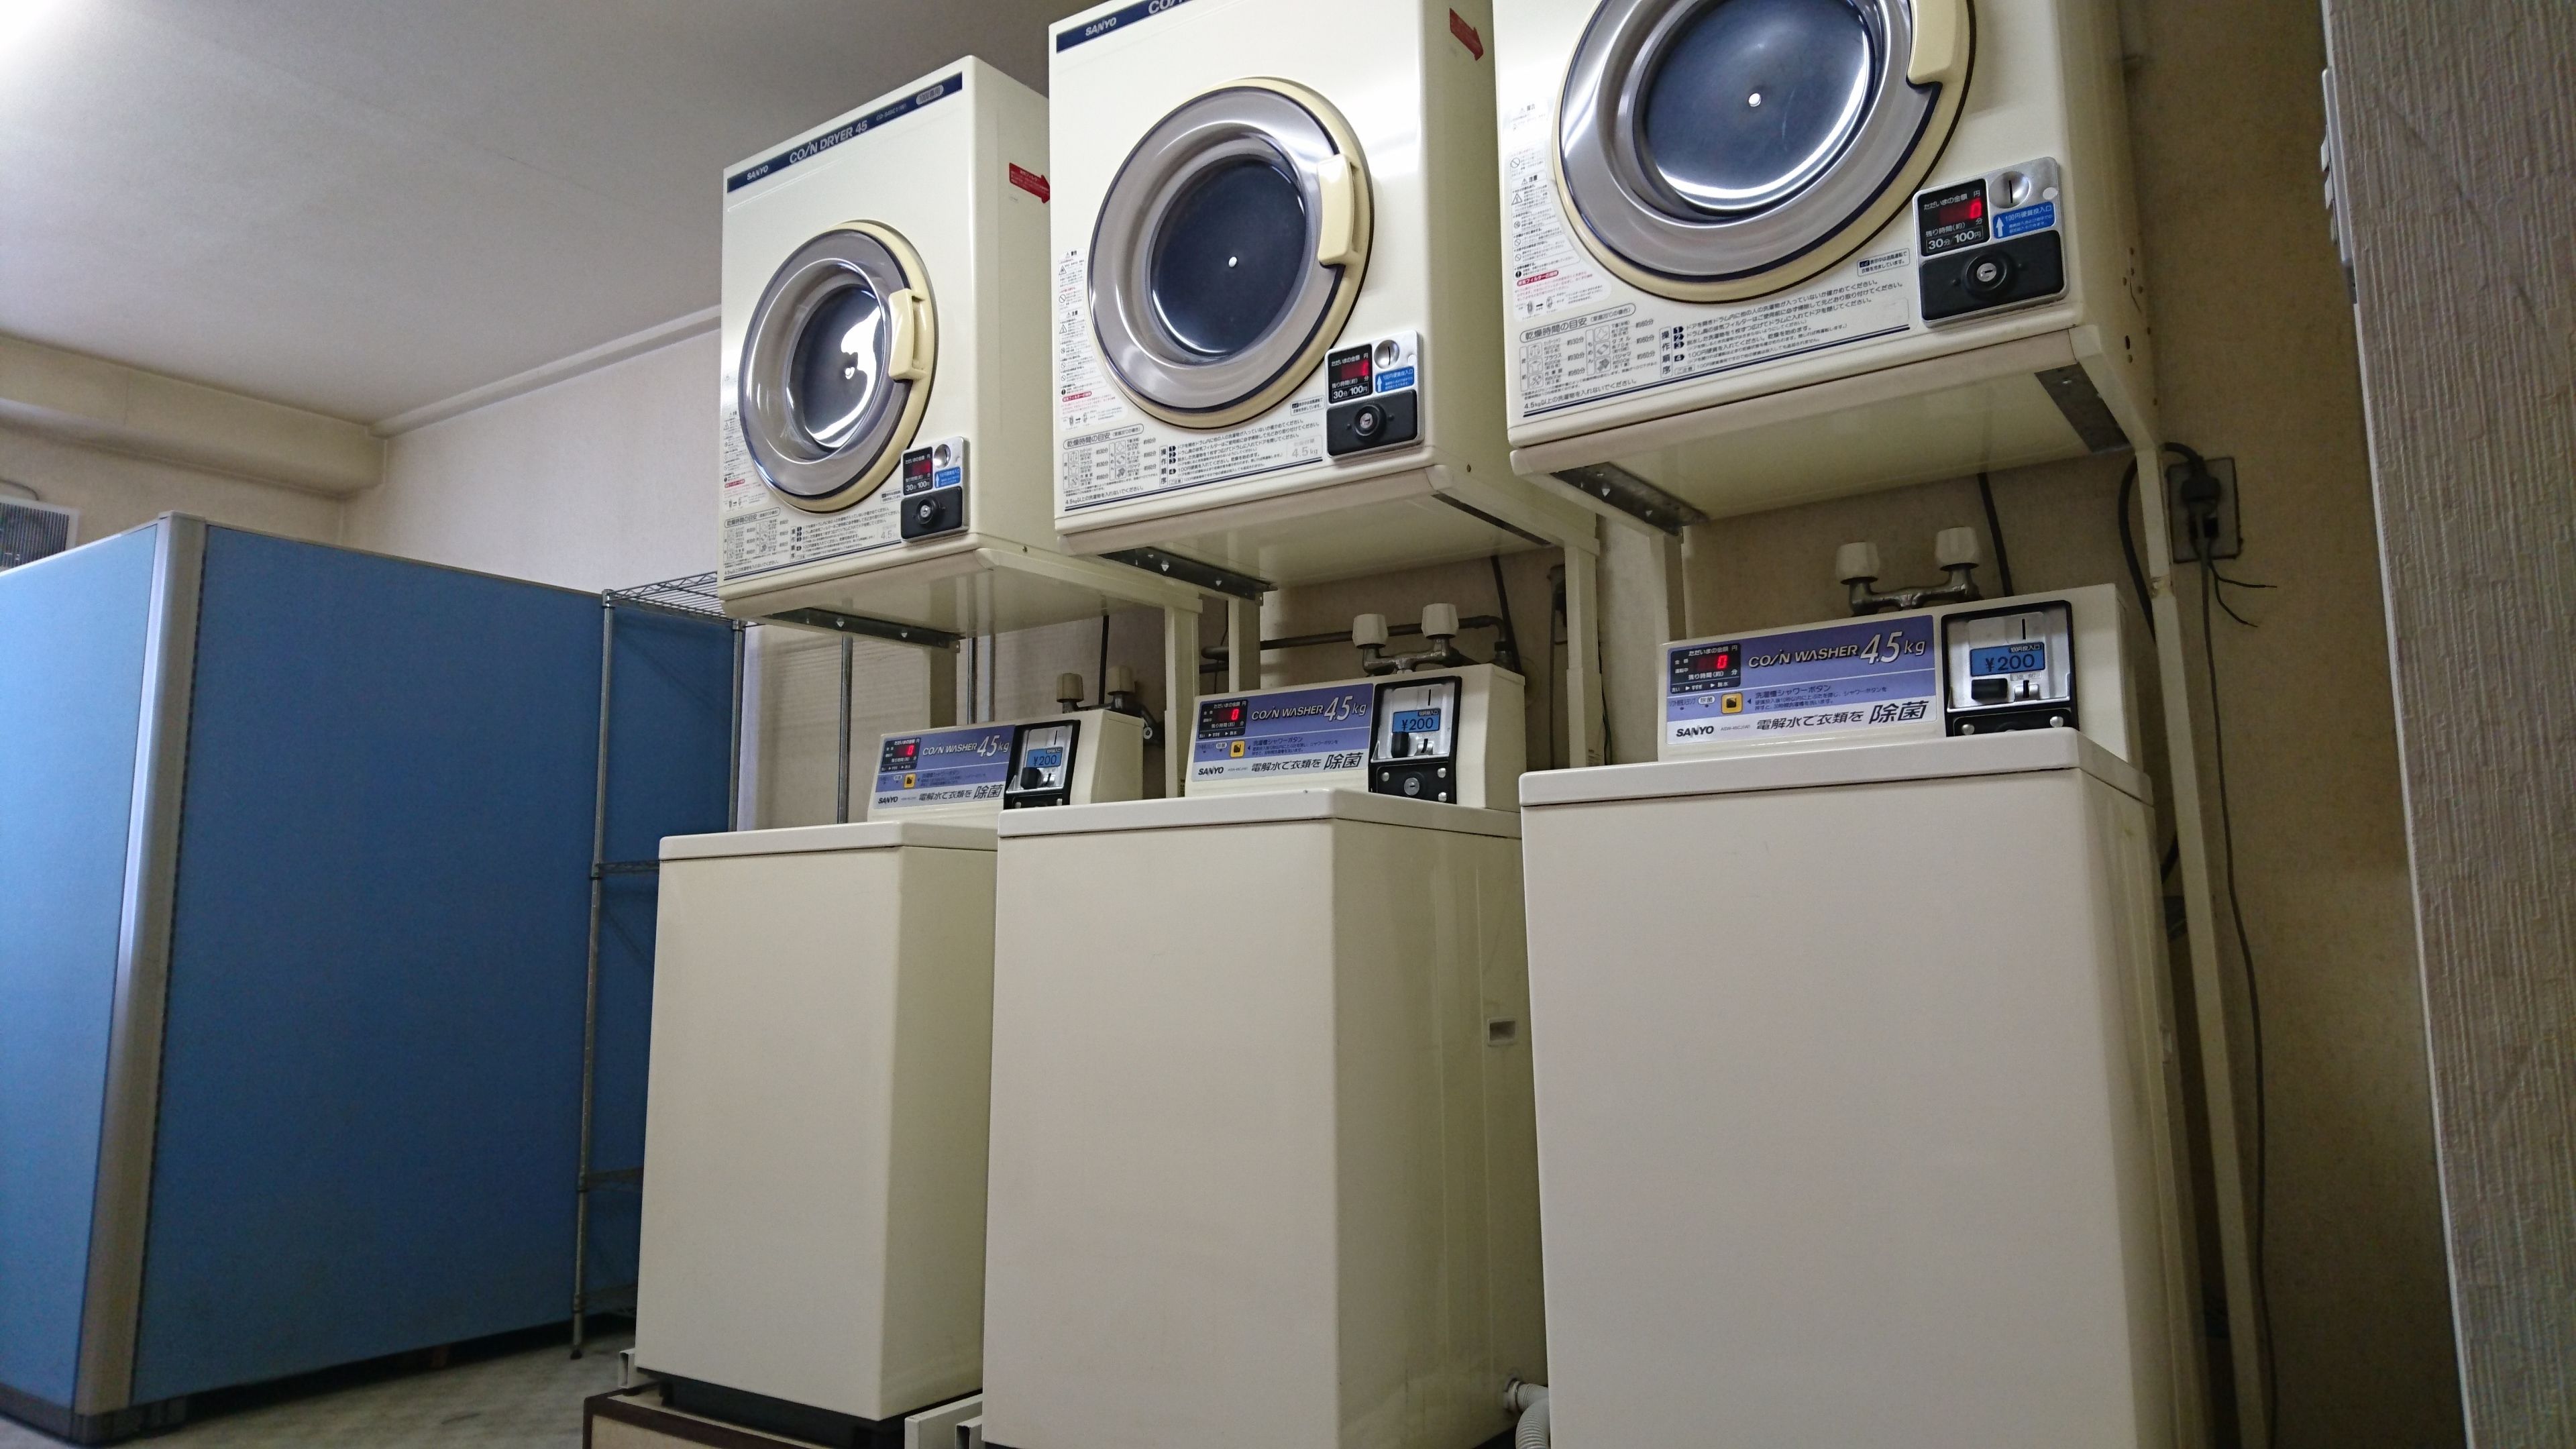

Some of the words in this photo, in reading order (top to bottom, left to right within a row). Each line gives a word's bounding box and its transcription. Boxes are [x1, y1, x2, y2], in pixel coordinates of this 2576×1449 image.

[1148, 0, 1183, 13] CO
[1085, 17, 1116, 36] SANYO
[820, 127, 853, 150] DRYER
[855, 120, 868, 135] 45
[747, 165, 769, 180] SANYO
[1970, 200, 1982, 219] 0
[1525, 317, 1587, 340] 乾燥時間の目安
[1795, 645, 1858, 662] WASHER
[1904, 640, 1925, 655] kg
[1717, 655, 1728, 669] 0
[1986, 653, 2035, 672] ¥200
[1232, 708, 1240, 720] 0
[1282, 705, 1324, 717] WASHER
[1352, 703, 1366, 716] kg
[1757, 711, 1864, 730] 電解水で衣類を
[1868, 700, 1929, 724] 除菌
[1401, 717, 1434, 731] ¥200
[1676, 726, 1714, 737] SANYO
[908, 745, 914, 755] 0
[946, 743, 977, 753] WASHER
[998, 741, 1010, 752] kg
[1033, 755, 1057, 766] ¥200
[1252, 759, 1322, 772] 電解水で衣類を
[1324, 752, 1364, 770] 除菌
[1198, 767, 1224, 775] SANYO
[973, 784, 1004, 799] 除菌
[878, 796, 898, 804] SANYO
